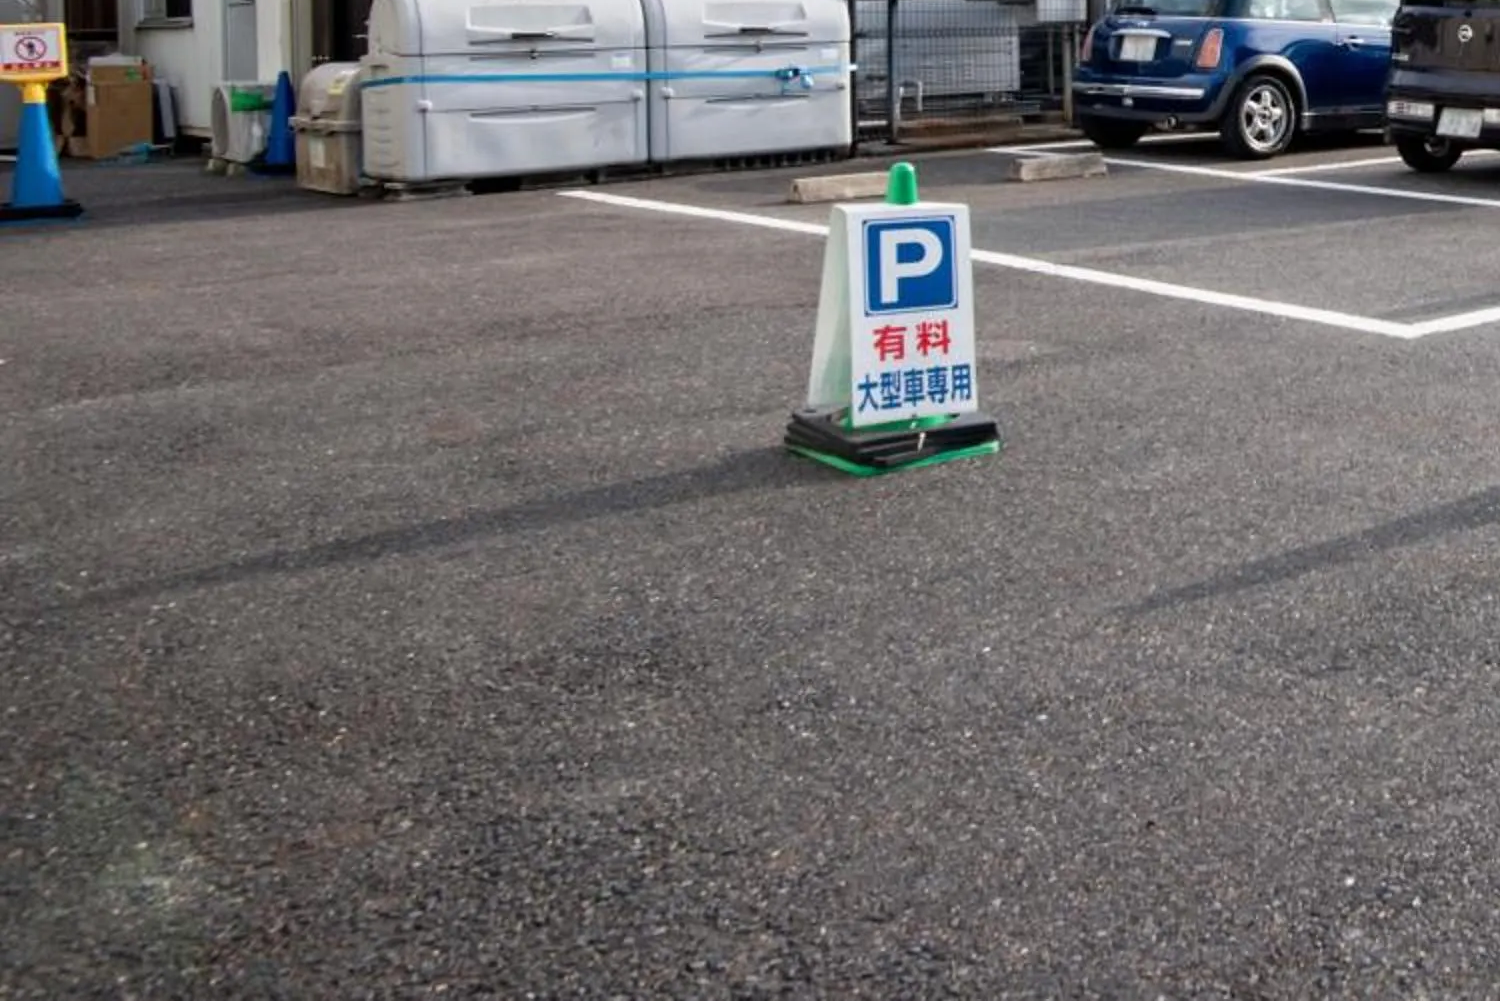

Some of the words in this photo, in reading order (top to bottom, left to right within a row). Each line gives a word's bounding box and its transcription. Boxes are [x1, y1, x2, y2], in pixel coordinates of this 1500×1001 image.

[879, 228, 943, 304] P
[873, 319, 952, 362] 有料
[857, 363, 973, 414] 大型車専用
